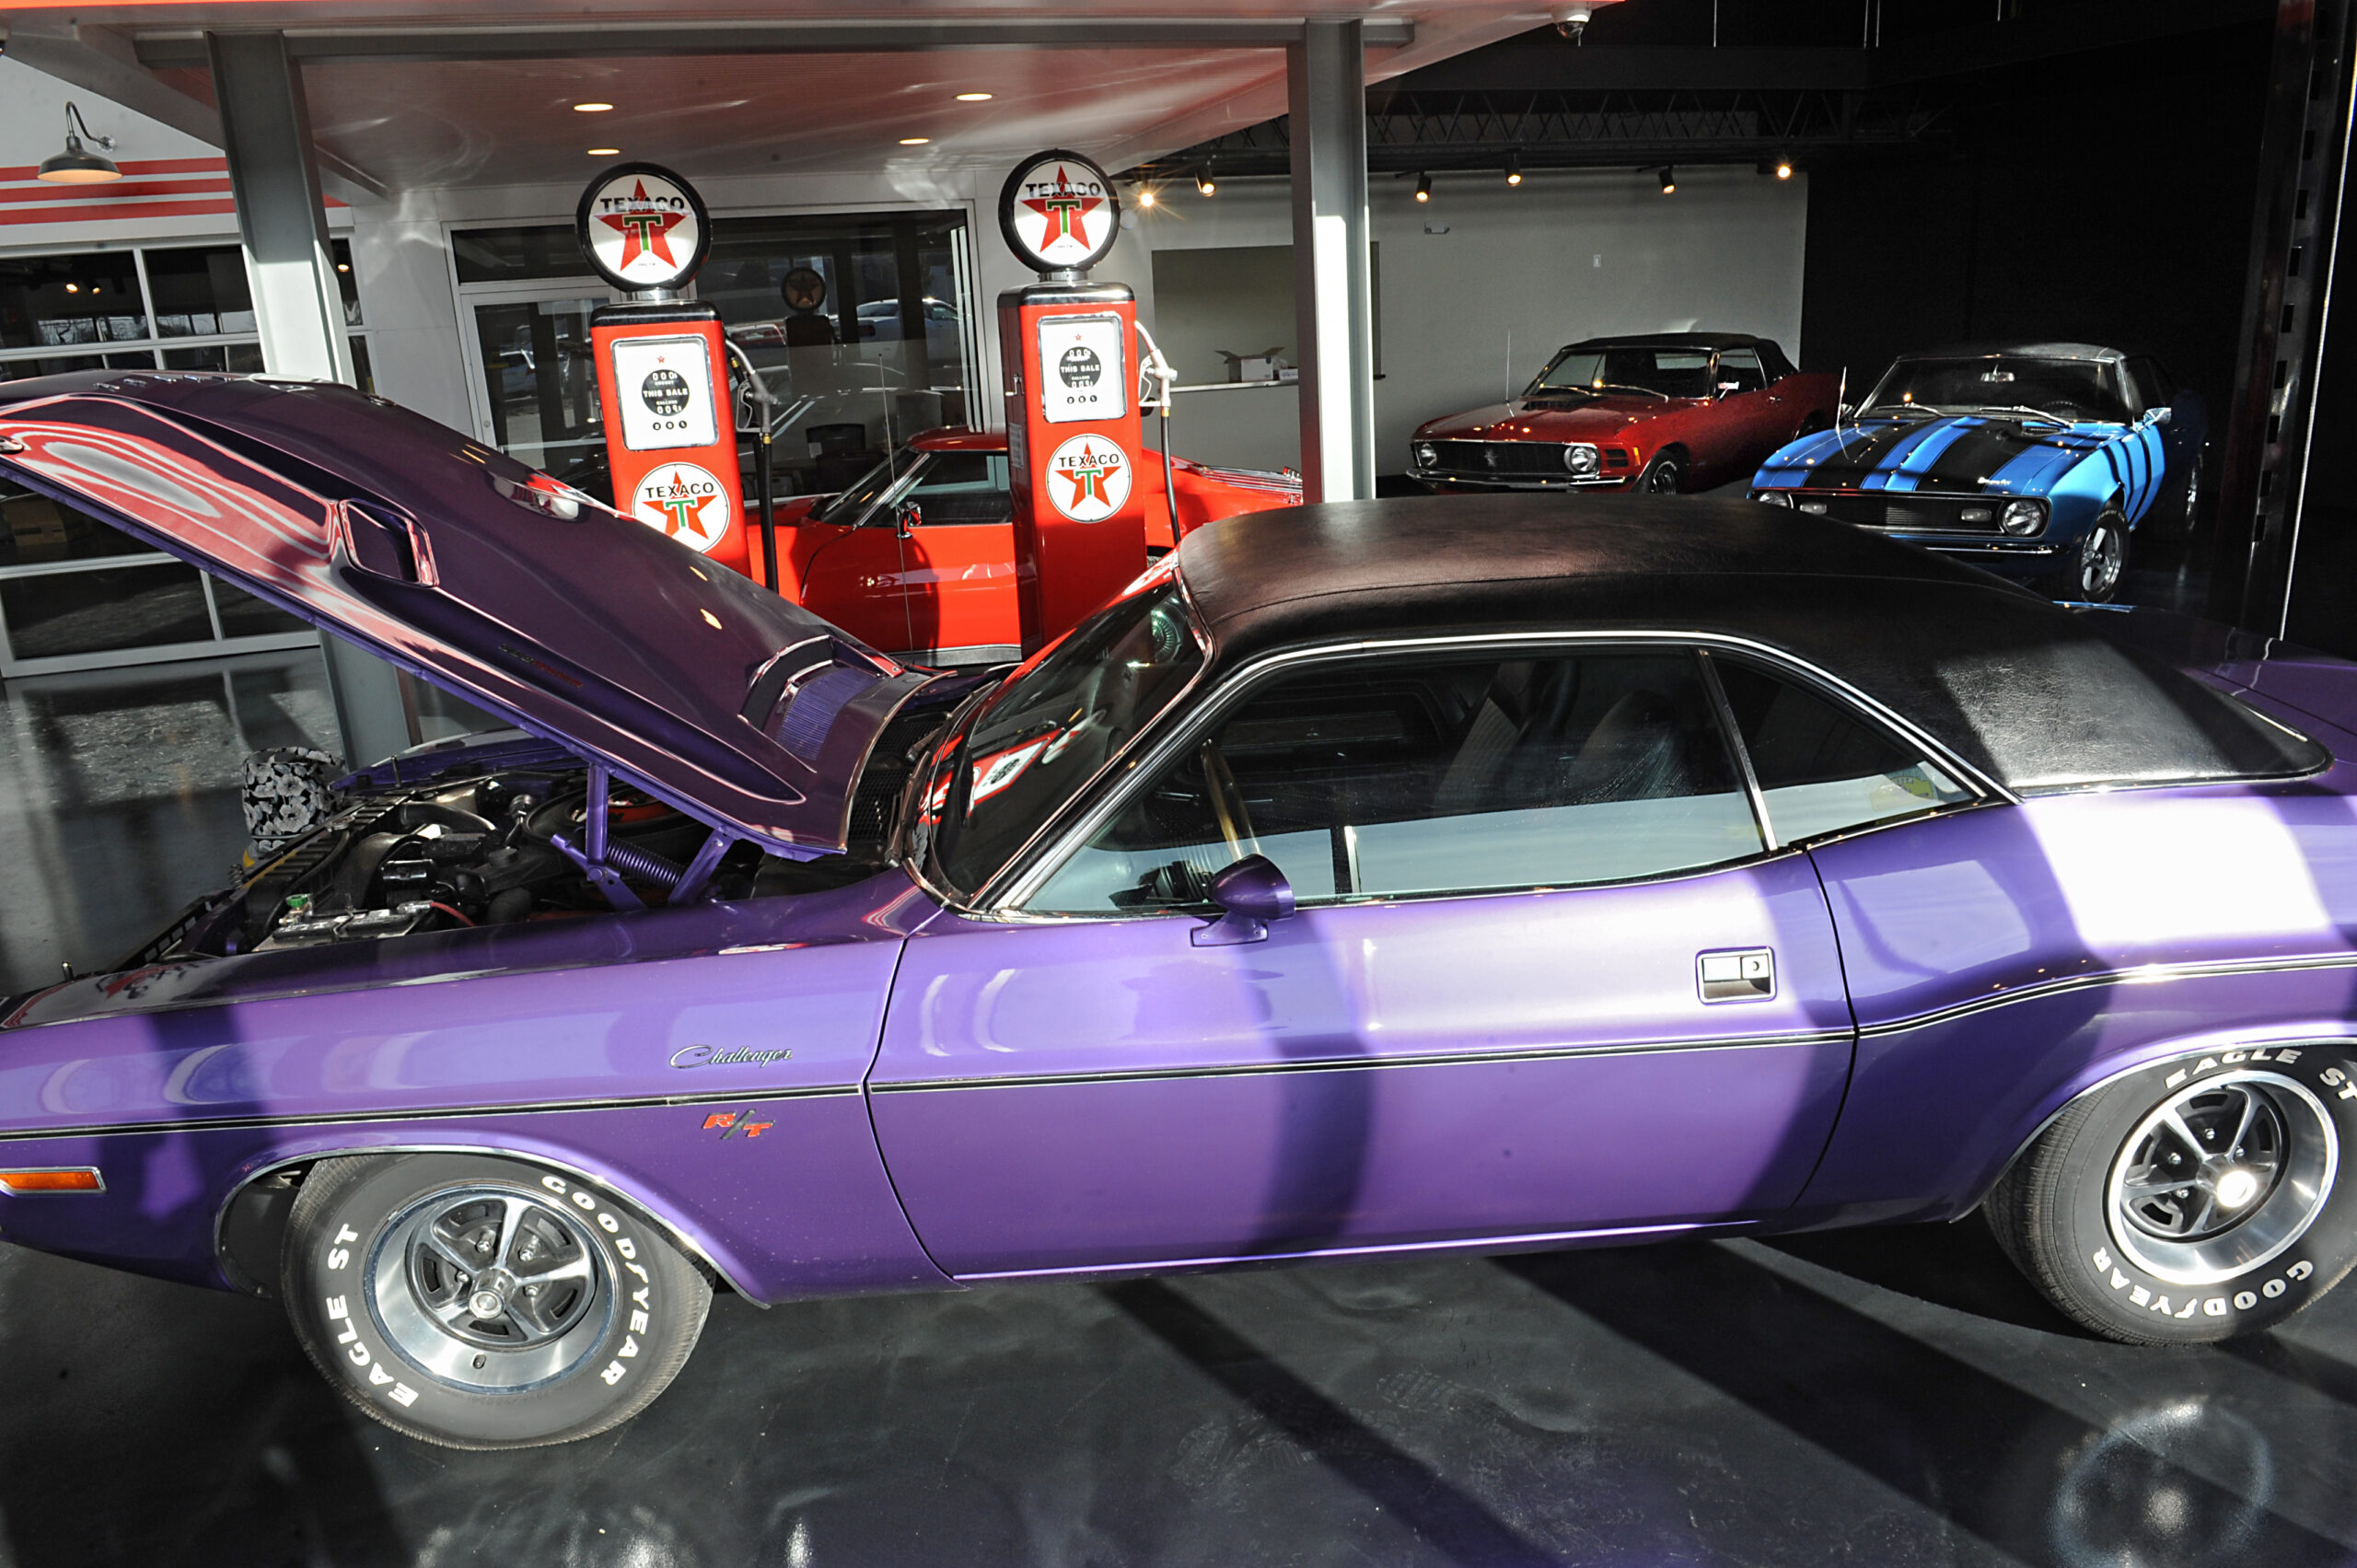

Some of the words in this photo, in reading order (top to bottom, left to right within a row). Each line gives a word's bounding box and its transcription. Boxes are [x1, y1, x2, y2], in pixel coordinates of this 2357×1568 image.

[1026, 181, 1101, 197] TEXACO
[599, 196, 685, 213] TEXACO
[643, 389, 663, 398] THIS
[666, 388, 688, 396] SALE
[1059, 453, 1120, 468] TEXACO
[644, 482, 714, 499] TEXACO
[669, 1044, 794, 1069] Challenger
[2165, 1047, 2302, 1089] EAGLE
[2319, 1067, 2357, 1101] ST
[702, 1109, 776, 1140] R/T
[327, 1223, 360, 1271] ST
[541, 1175, 650, 1387] GOODYEAR
[2091, 1246, 2315, 1319] GOODYEAR
[325, 1294, 420, 1408] EAGLE
